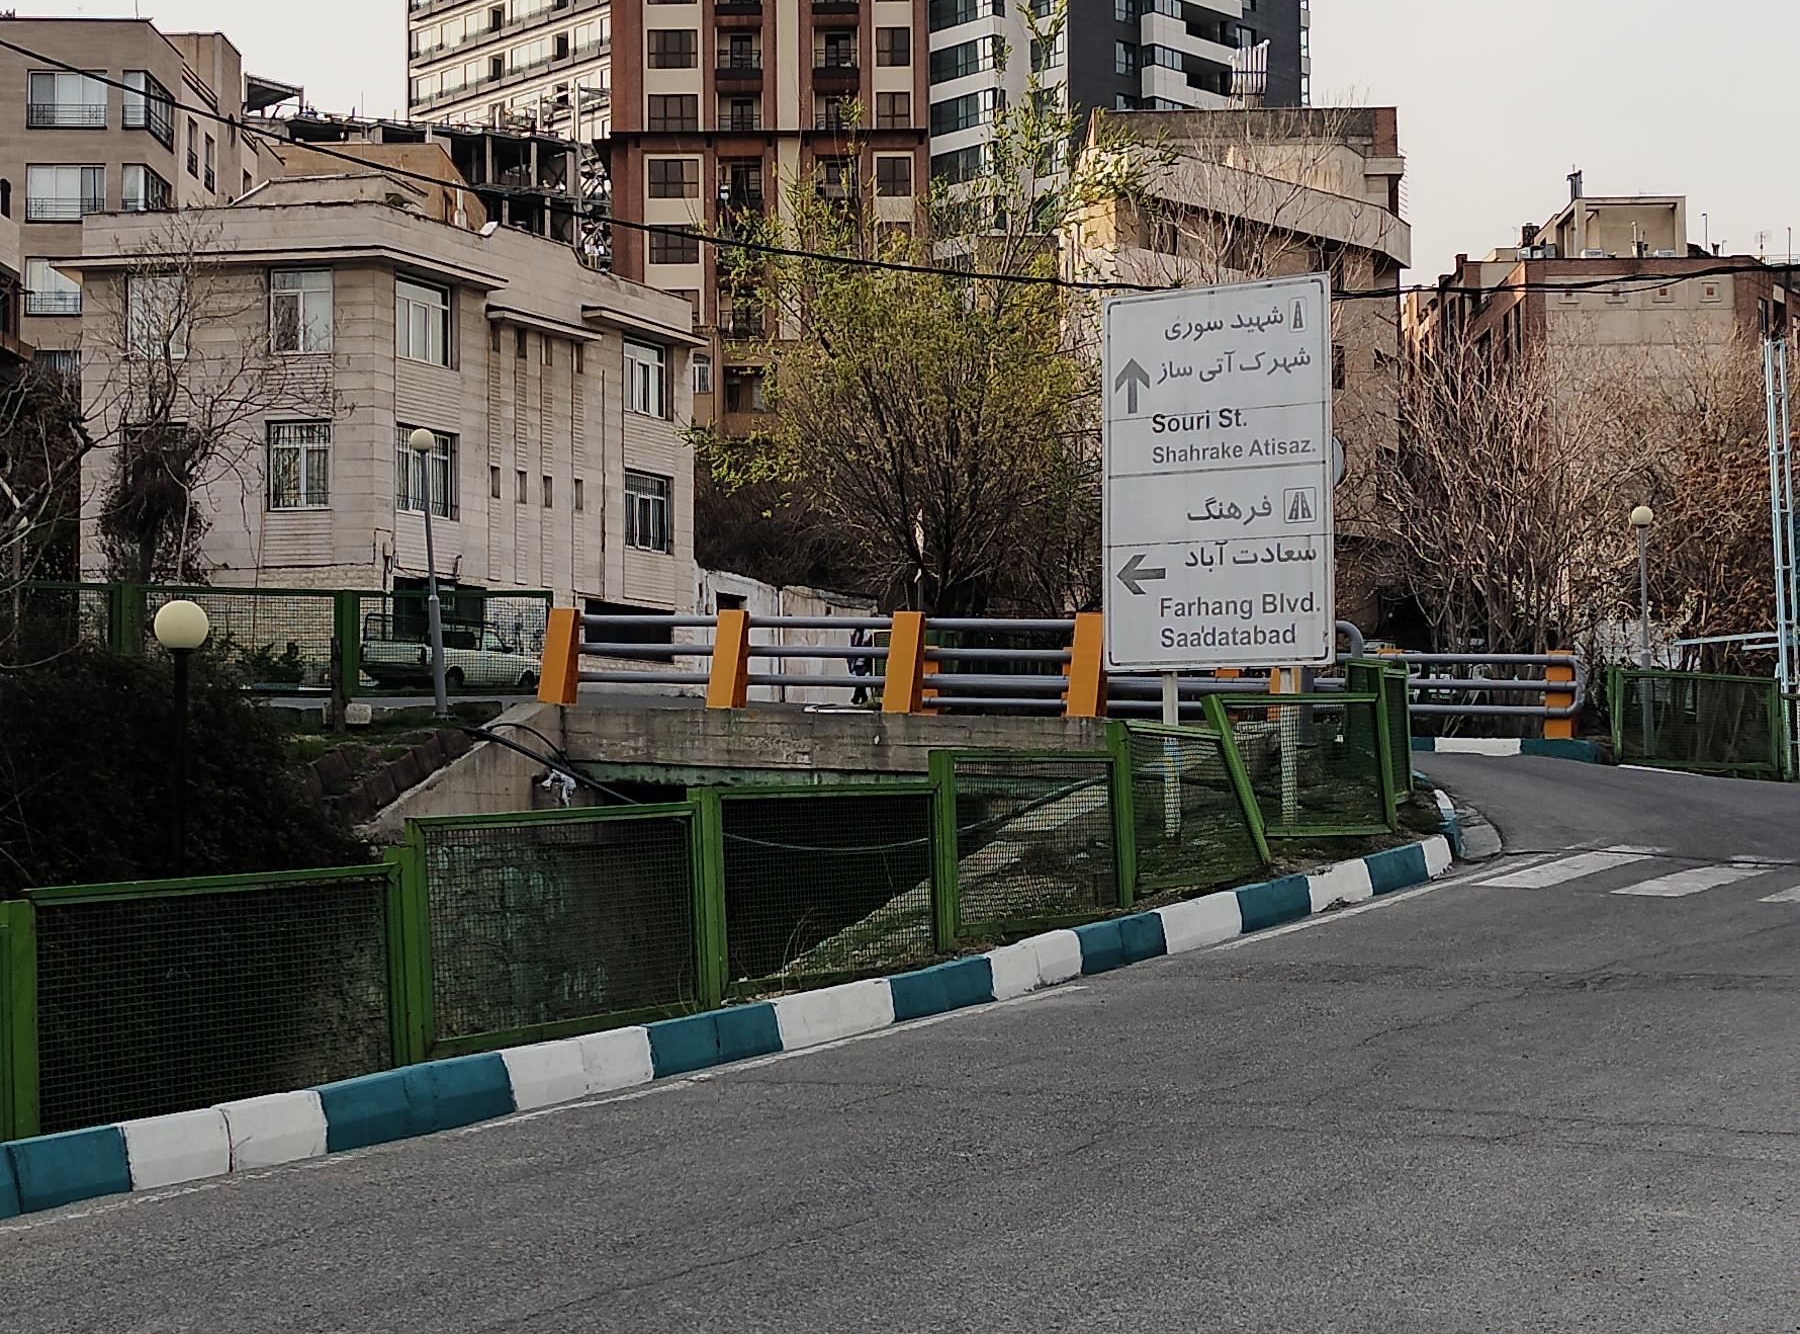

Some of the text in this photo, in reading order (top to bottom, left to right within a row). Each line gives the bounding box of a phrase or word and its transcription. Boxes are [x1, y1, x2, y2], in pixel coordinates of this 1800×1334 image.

[1164, 306, 1284, 342] شهید سوری
[1156, 347, 1311, 385] شهرک آتی ساز
[1152, 408, 1247, 434] Souri St.
[1152, 438, 1316, 464] Shahrake Atisaz.
[1187, 495, 1273, 526] فرهنگ
[1185, 539, 1317, 572] سعادت آباد
[1160, 591, 1321, 620] Farhang Blvd.
[1161, 623, 1296, 648] Saa'databad
